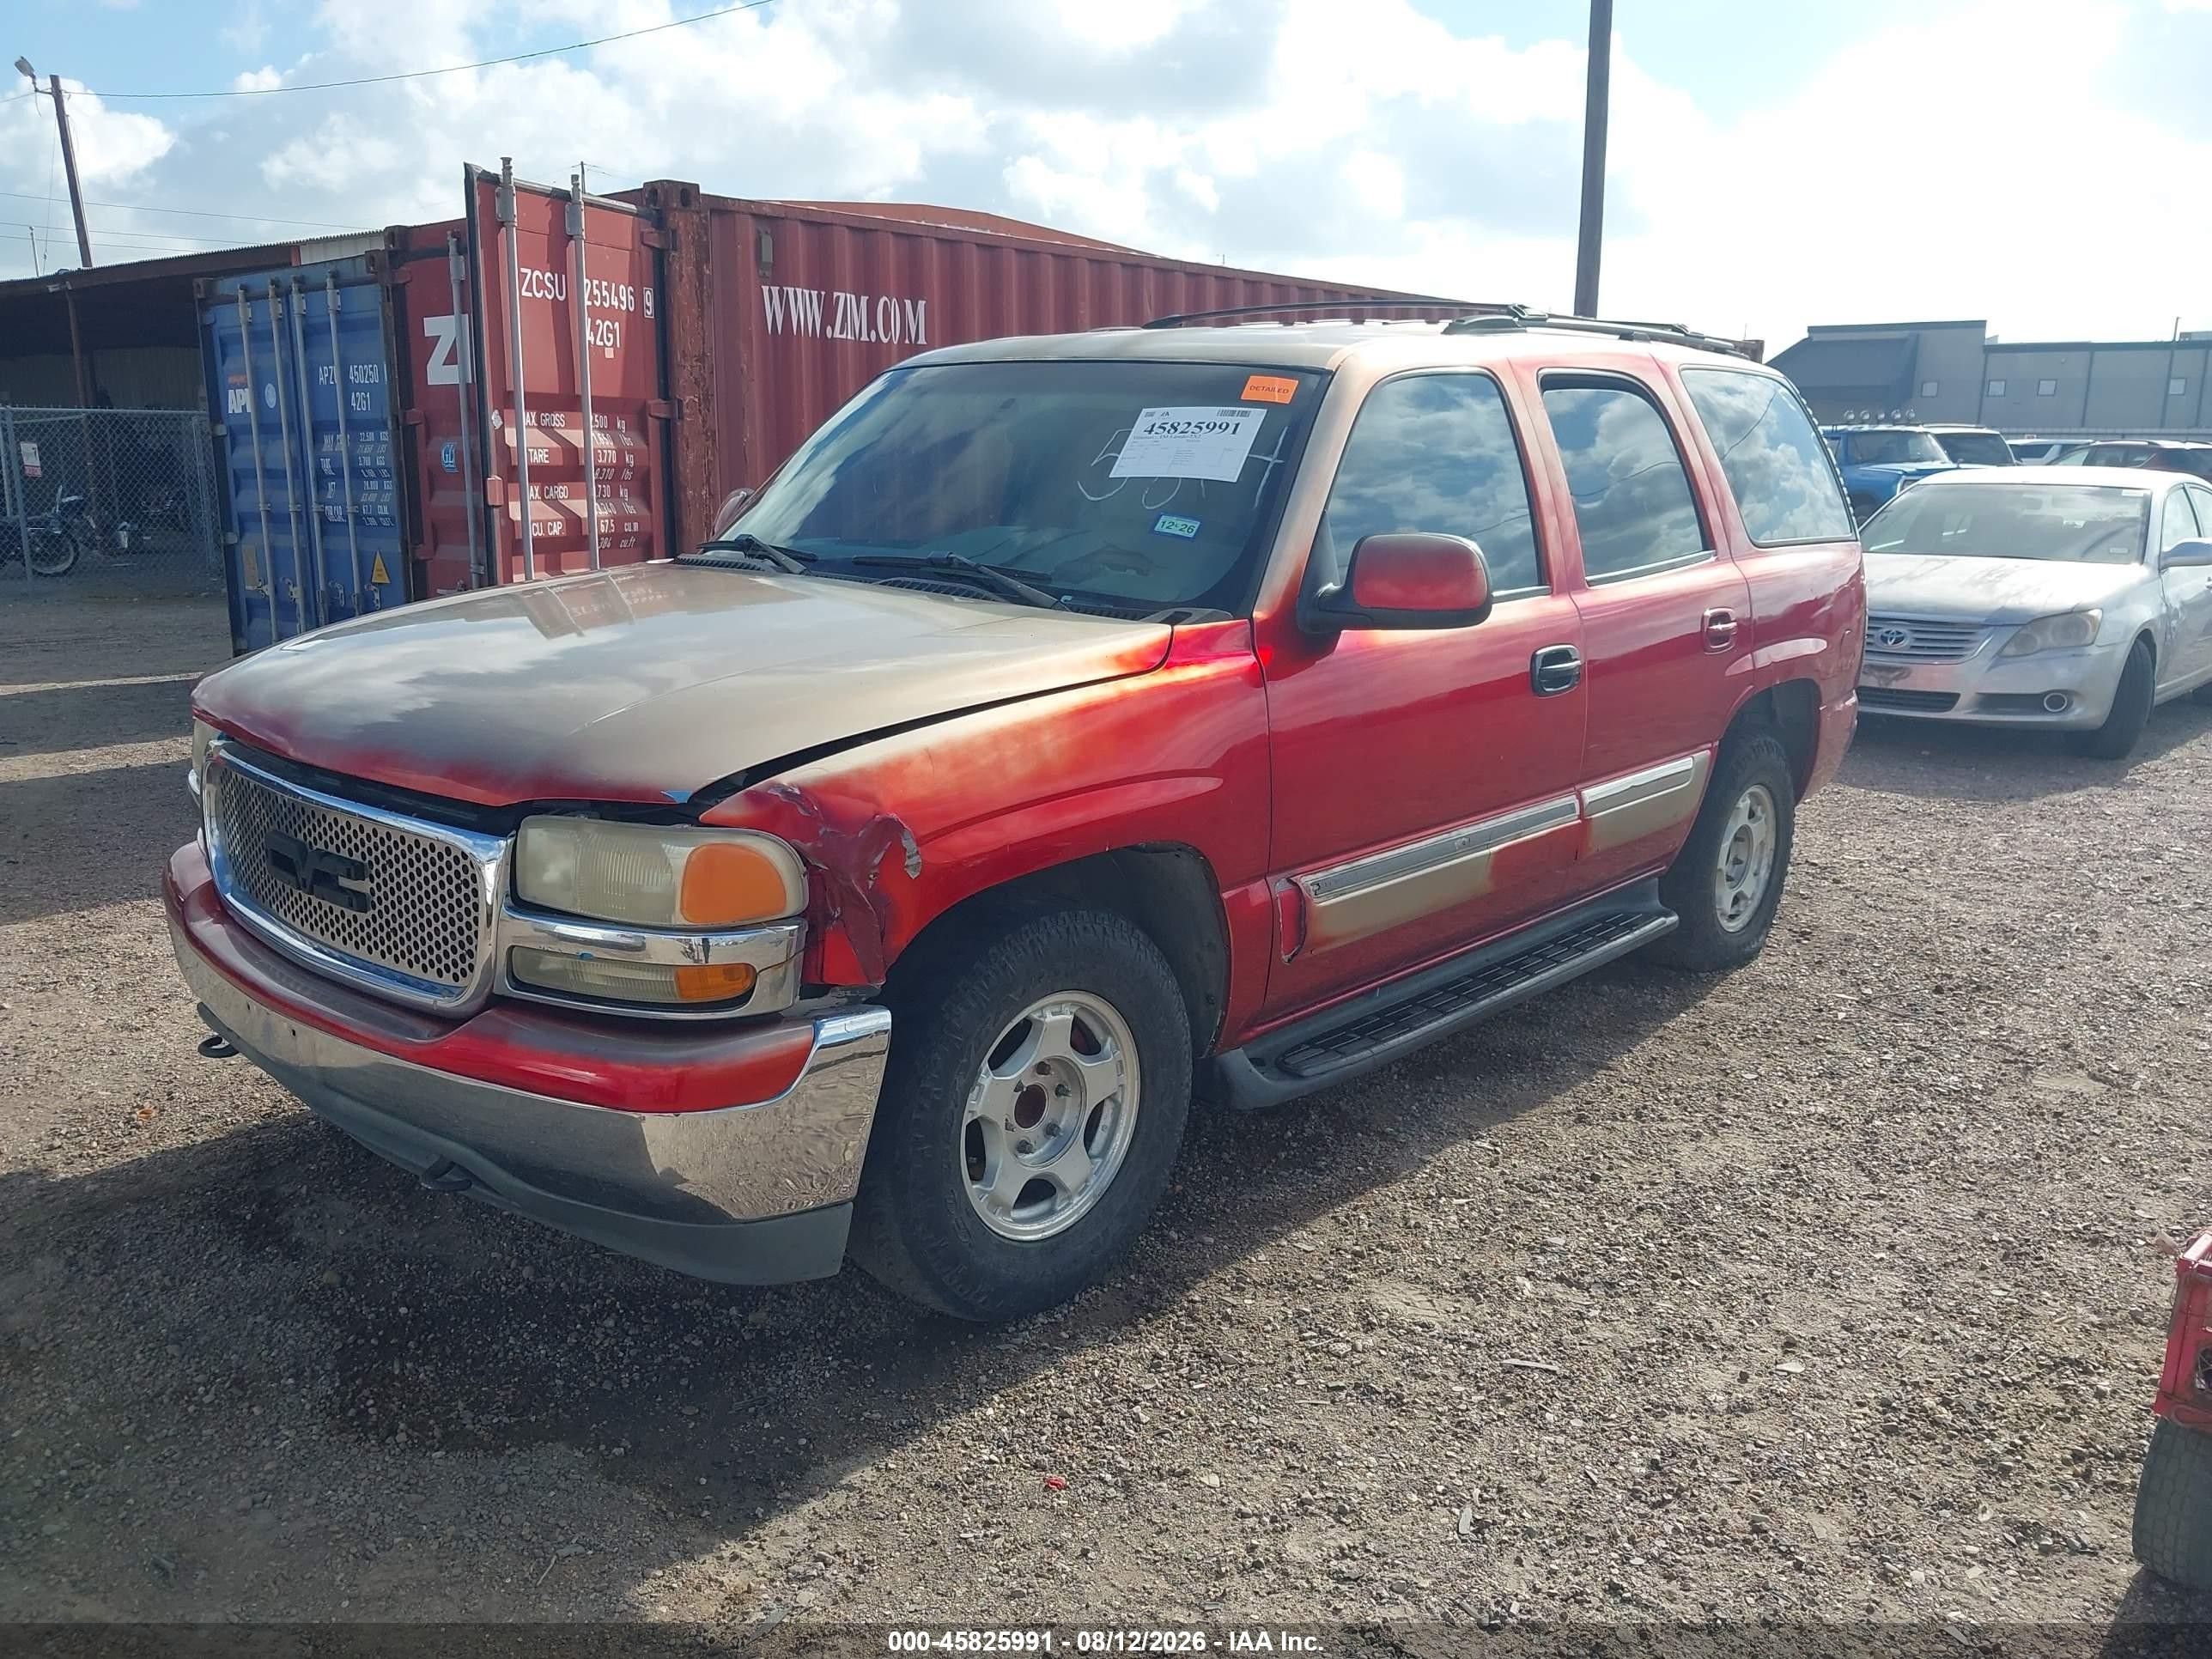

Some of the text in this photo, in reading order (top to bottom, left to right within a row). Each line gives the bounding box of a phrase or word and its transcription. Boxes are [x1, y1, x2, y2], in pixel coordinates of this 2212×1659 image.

[520, 267, 653, 316] ZCSU 255496 9
[586, 317, 620, 348] 42G1
[349, 364, 379, 385] 450250
[1249, 385, 1290, 395] DETAILED
[351, 392, 371, 411] 42G1
[526, 411, 538, 427] AX.
[540, 412, 565, 428] GROSS
[617, 416, 626, 433] kg
[1144, 421, 1241, 435] 45825991
[619, 434, 634, 447] lbs
[528, 448, 634, 466] TARE 3.770 kg
[621, 468, 633, 481] lbs
[529, 485, 541, 500] AX.
[544, 485, 568, 500] CARGO
[619, 484, 629, 501] kg
[623, 501, 637, 514] lbs
[532, 522, 544, 536] CU.
[548, 521, 564, 536] CAP.
[599, 519, 615, 532] 67.5
[1160, 520, 1195, 533] 12 26
